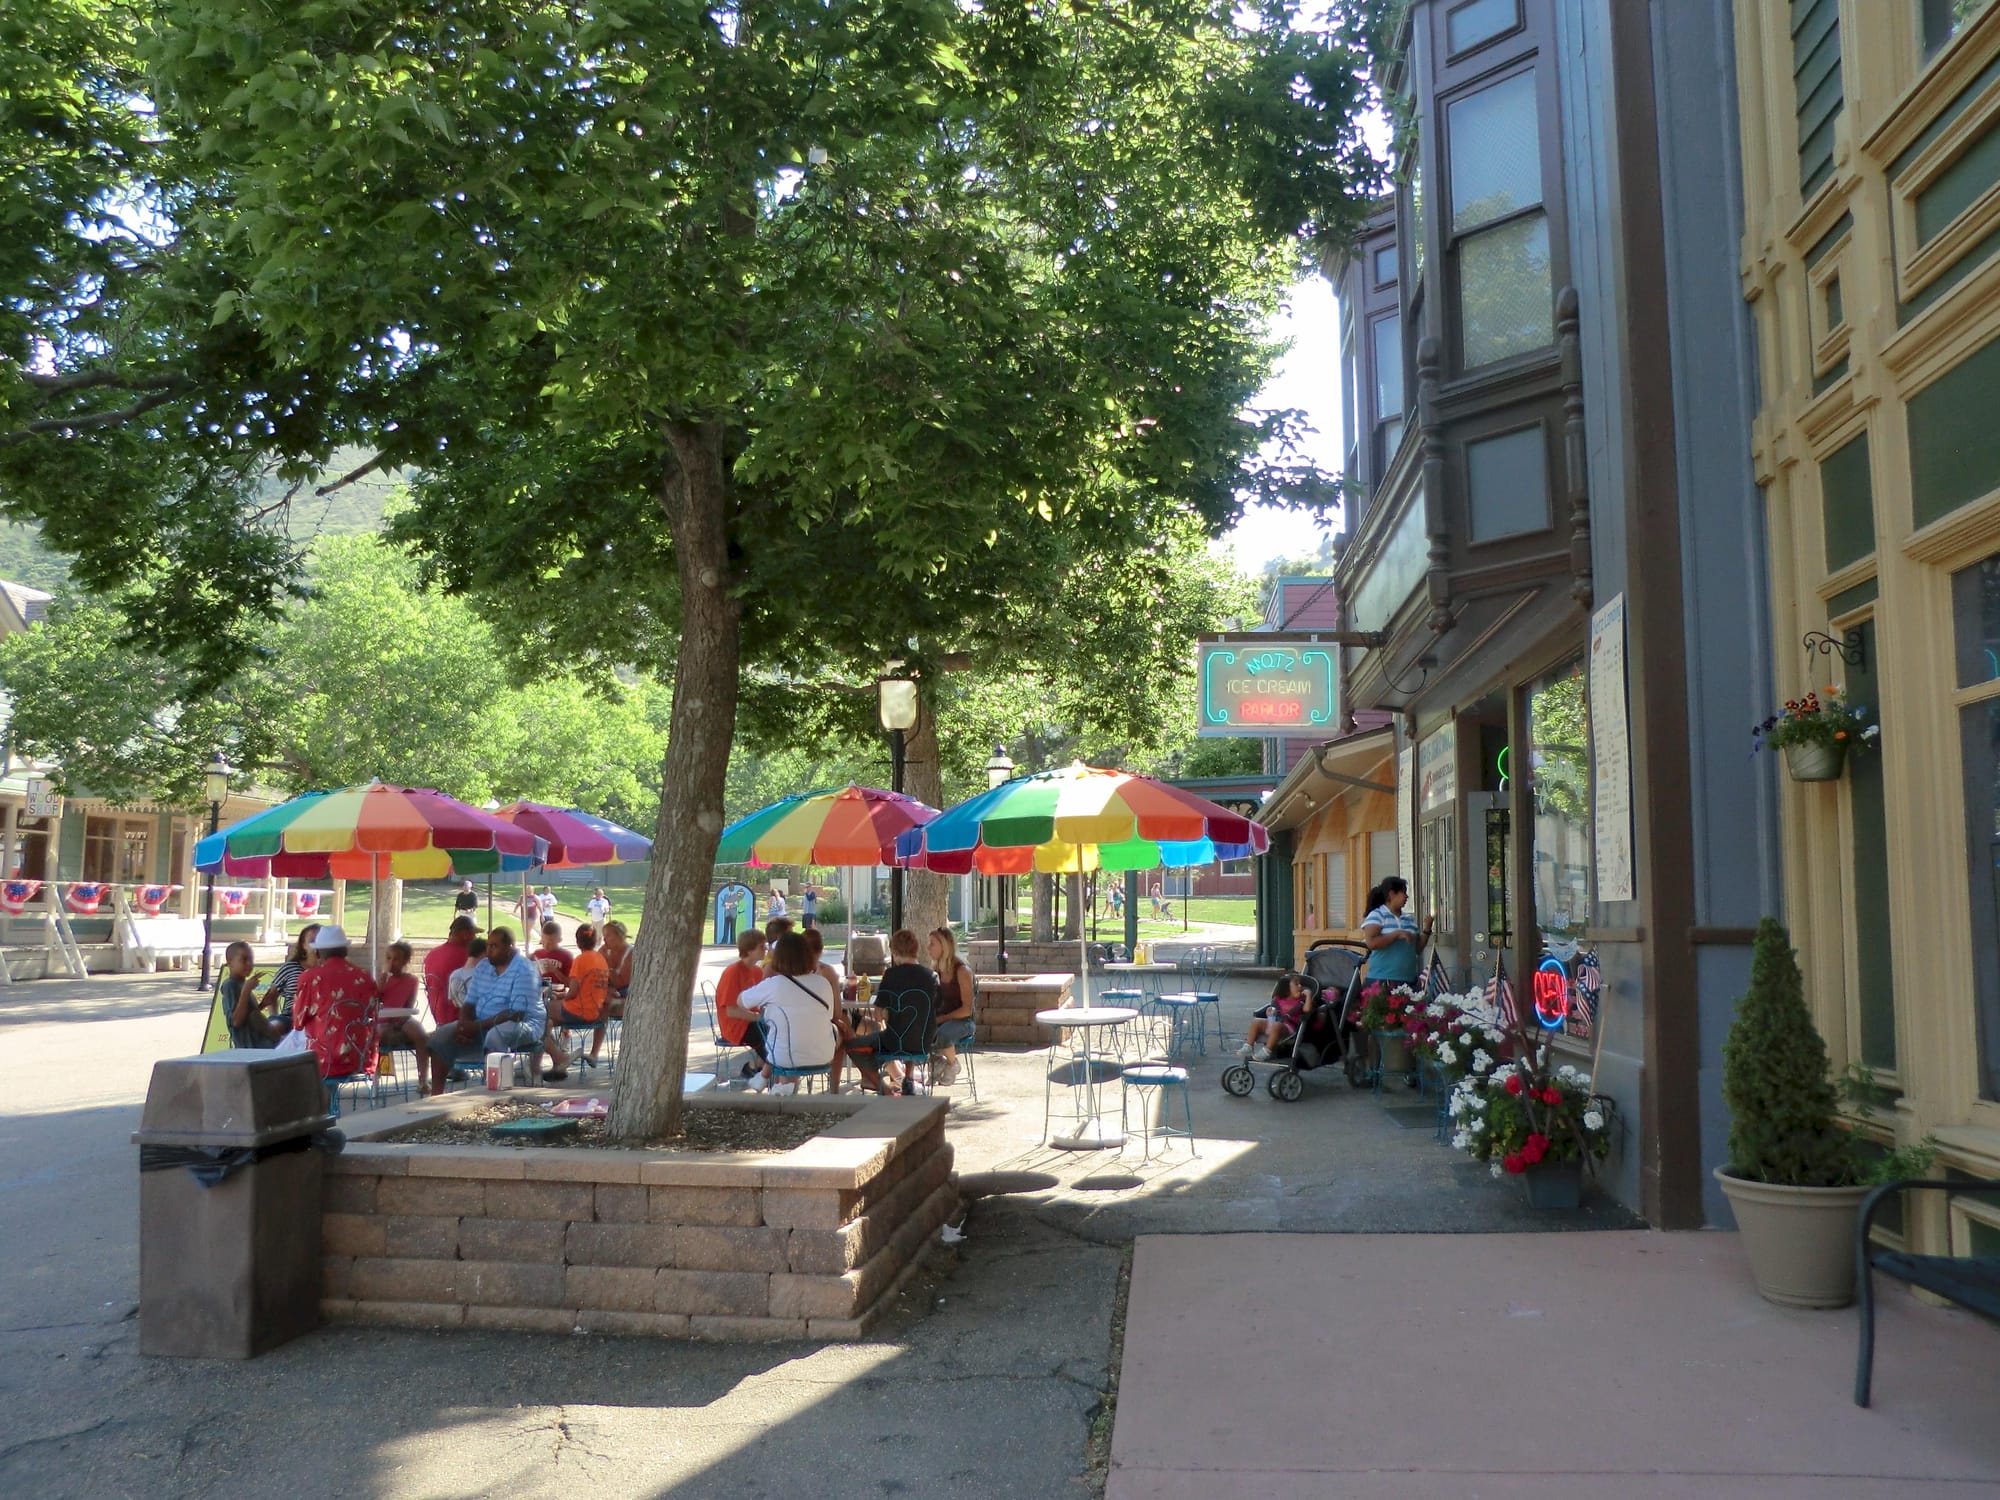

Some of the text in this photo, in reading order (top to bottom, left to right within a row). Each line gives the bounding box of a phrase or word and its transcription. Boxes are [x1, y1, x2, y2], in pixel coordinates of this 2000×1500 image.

[1227, 680, 1311, 694] ICE CREAM
[1241, 703, 1299, 717] PARLOR
[29, 804, 58, 814] SHOP
[1534, 972, 1567, 1016] OPEN
